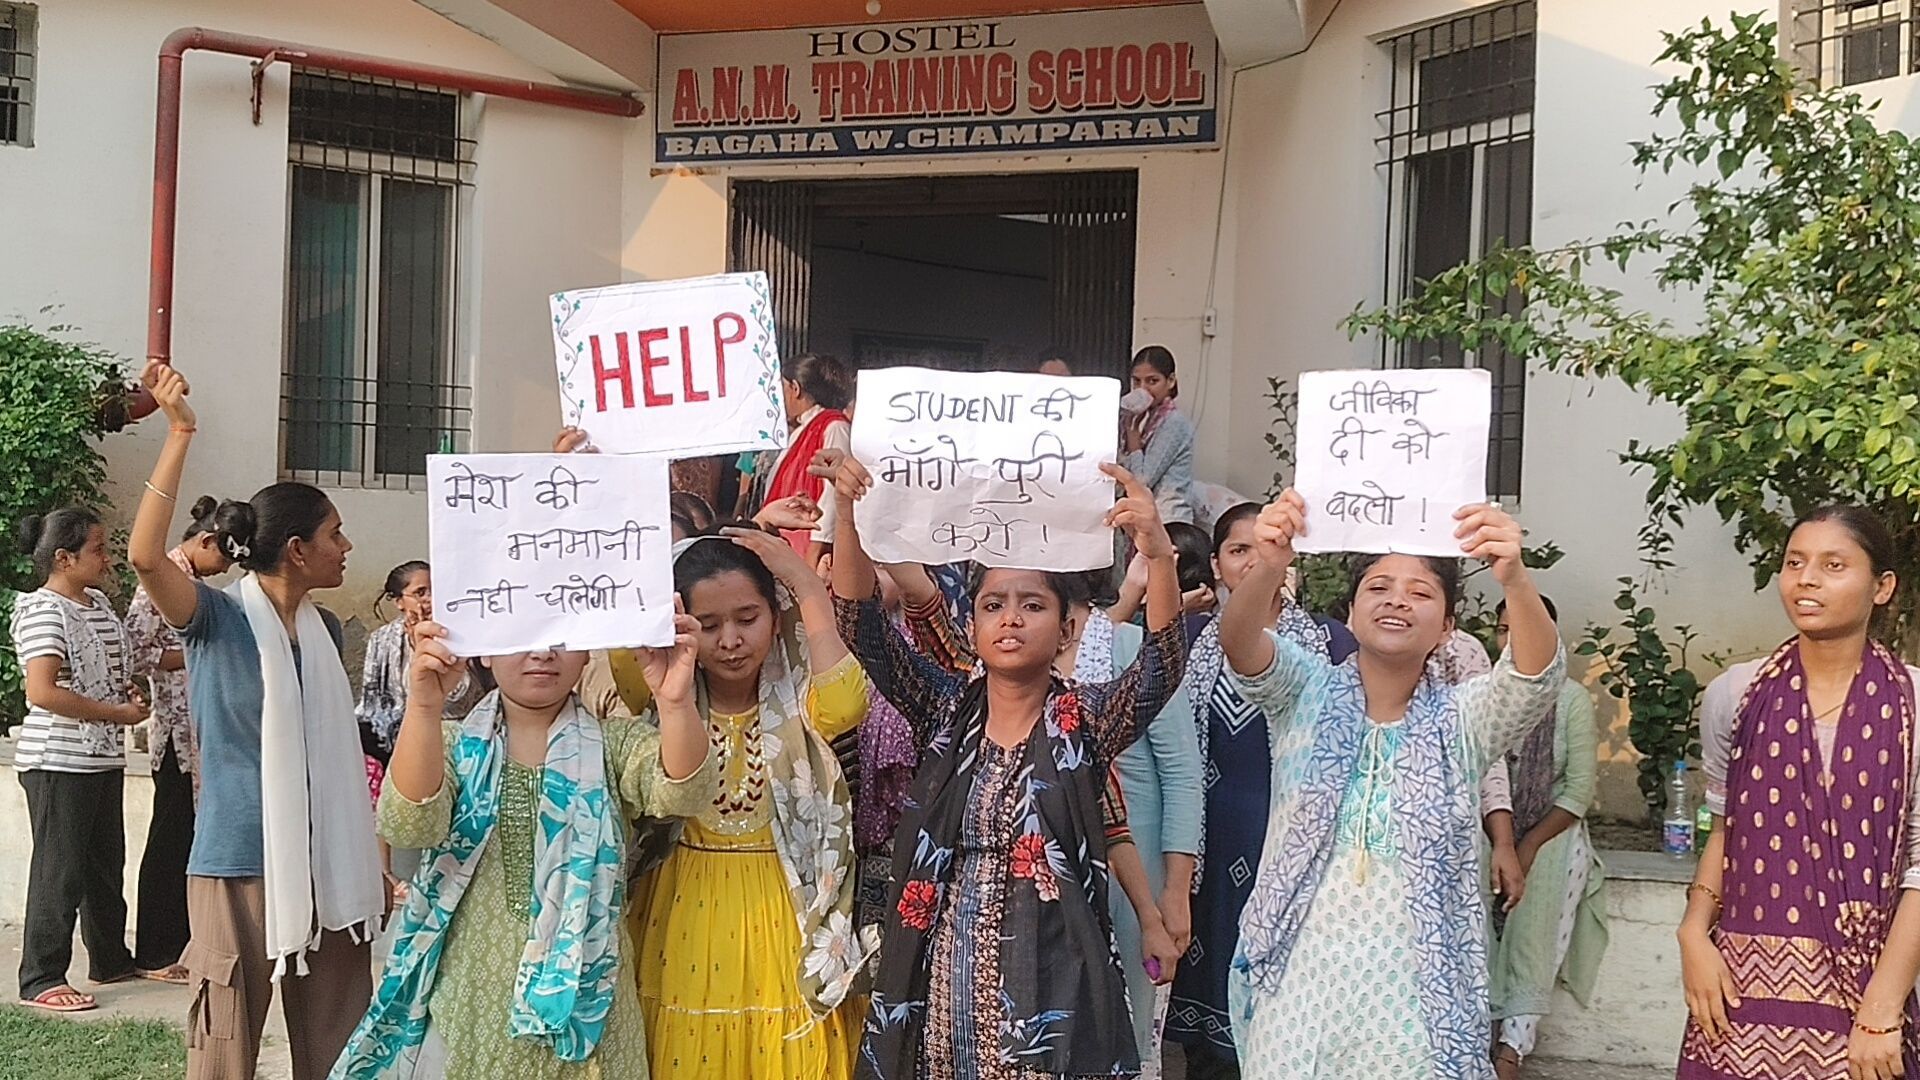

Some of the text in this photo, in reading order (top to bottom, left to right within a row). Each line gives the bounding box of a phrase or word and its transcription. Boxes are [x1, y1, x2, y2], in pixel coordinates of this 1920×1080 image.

[808, 23, 1016, 57] HOSTEL
[673, 42, 1204, 127] A.N.M. TRAINING SCHOOL
[665, 116, 1200, 157] BAGAHA W.CHAMPARAN
[589, 311, 747, 412] HELP
[886, 387, 1093, 424] STUDENT की
[1329, 380, 1438, 415] जीविका
[1329, 416, 1451, 466] दी को
[534, 465, 600, 509] की
[507, 520, 660, 561] मनमानी
[446, 579, 529, 619] नही
